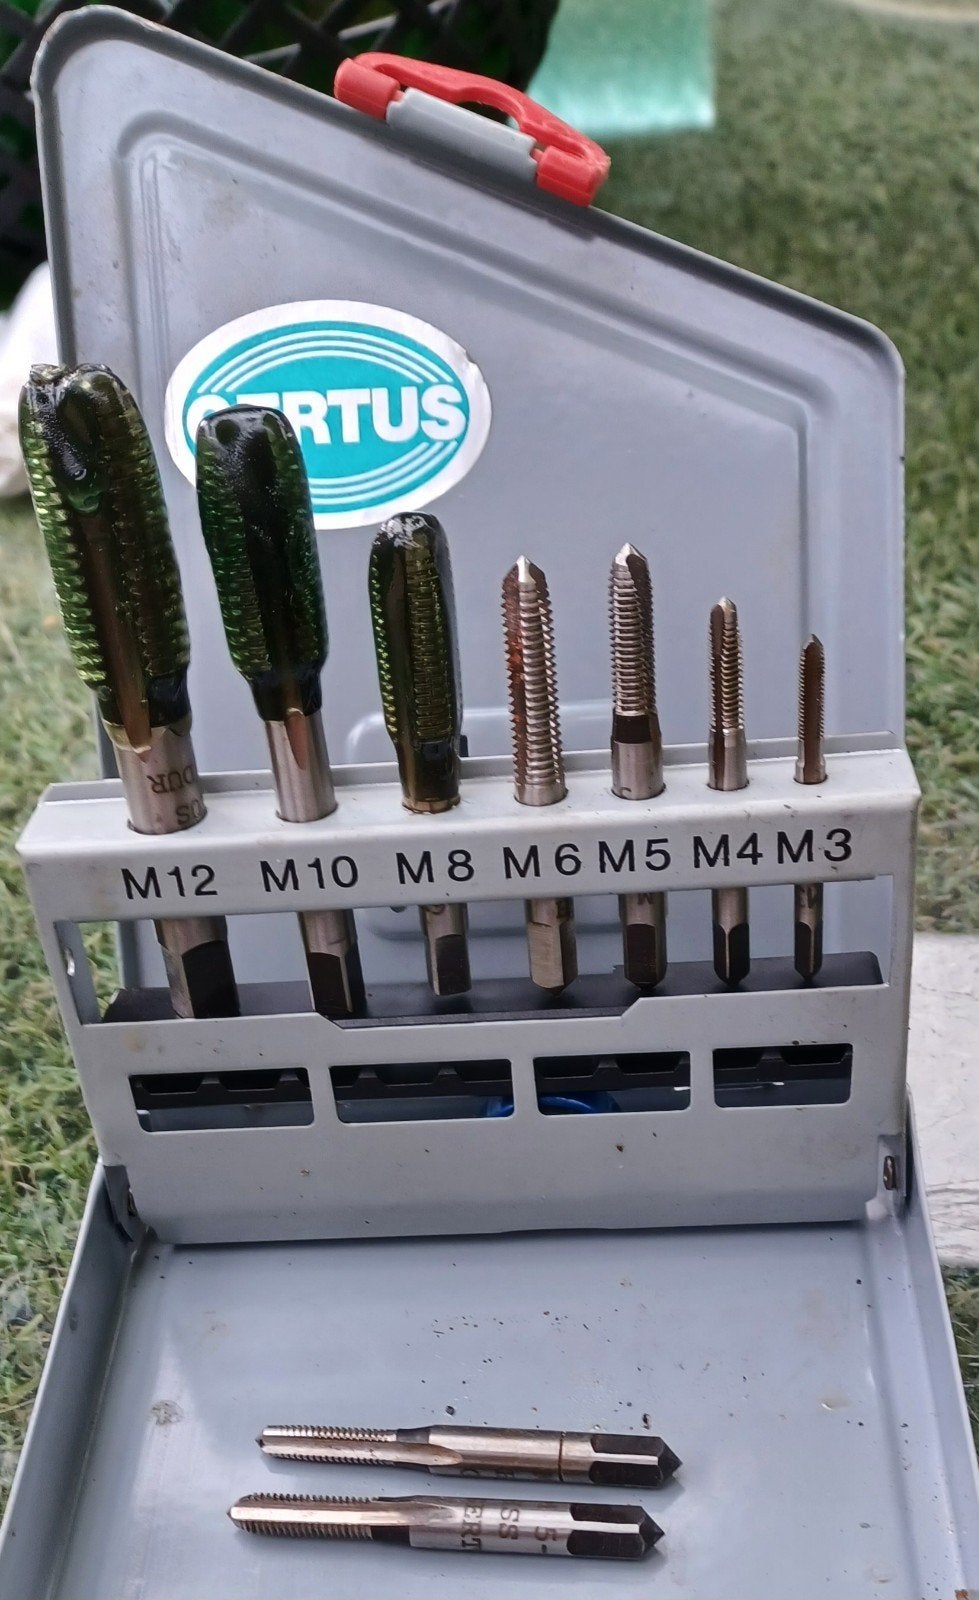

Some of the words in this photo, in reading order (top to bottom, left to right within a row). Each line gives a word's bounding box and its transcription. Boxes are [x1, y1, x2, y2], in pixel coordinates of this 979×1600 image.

[186, 384, 467, 444] CRTUS
[121, 864, 218, 900] M12
[260, 855, 359, 892] M10
[598, 838, 671, 873] M5
[693, 832, 763, 869] M4
